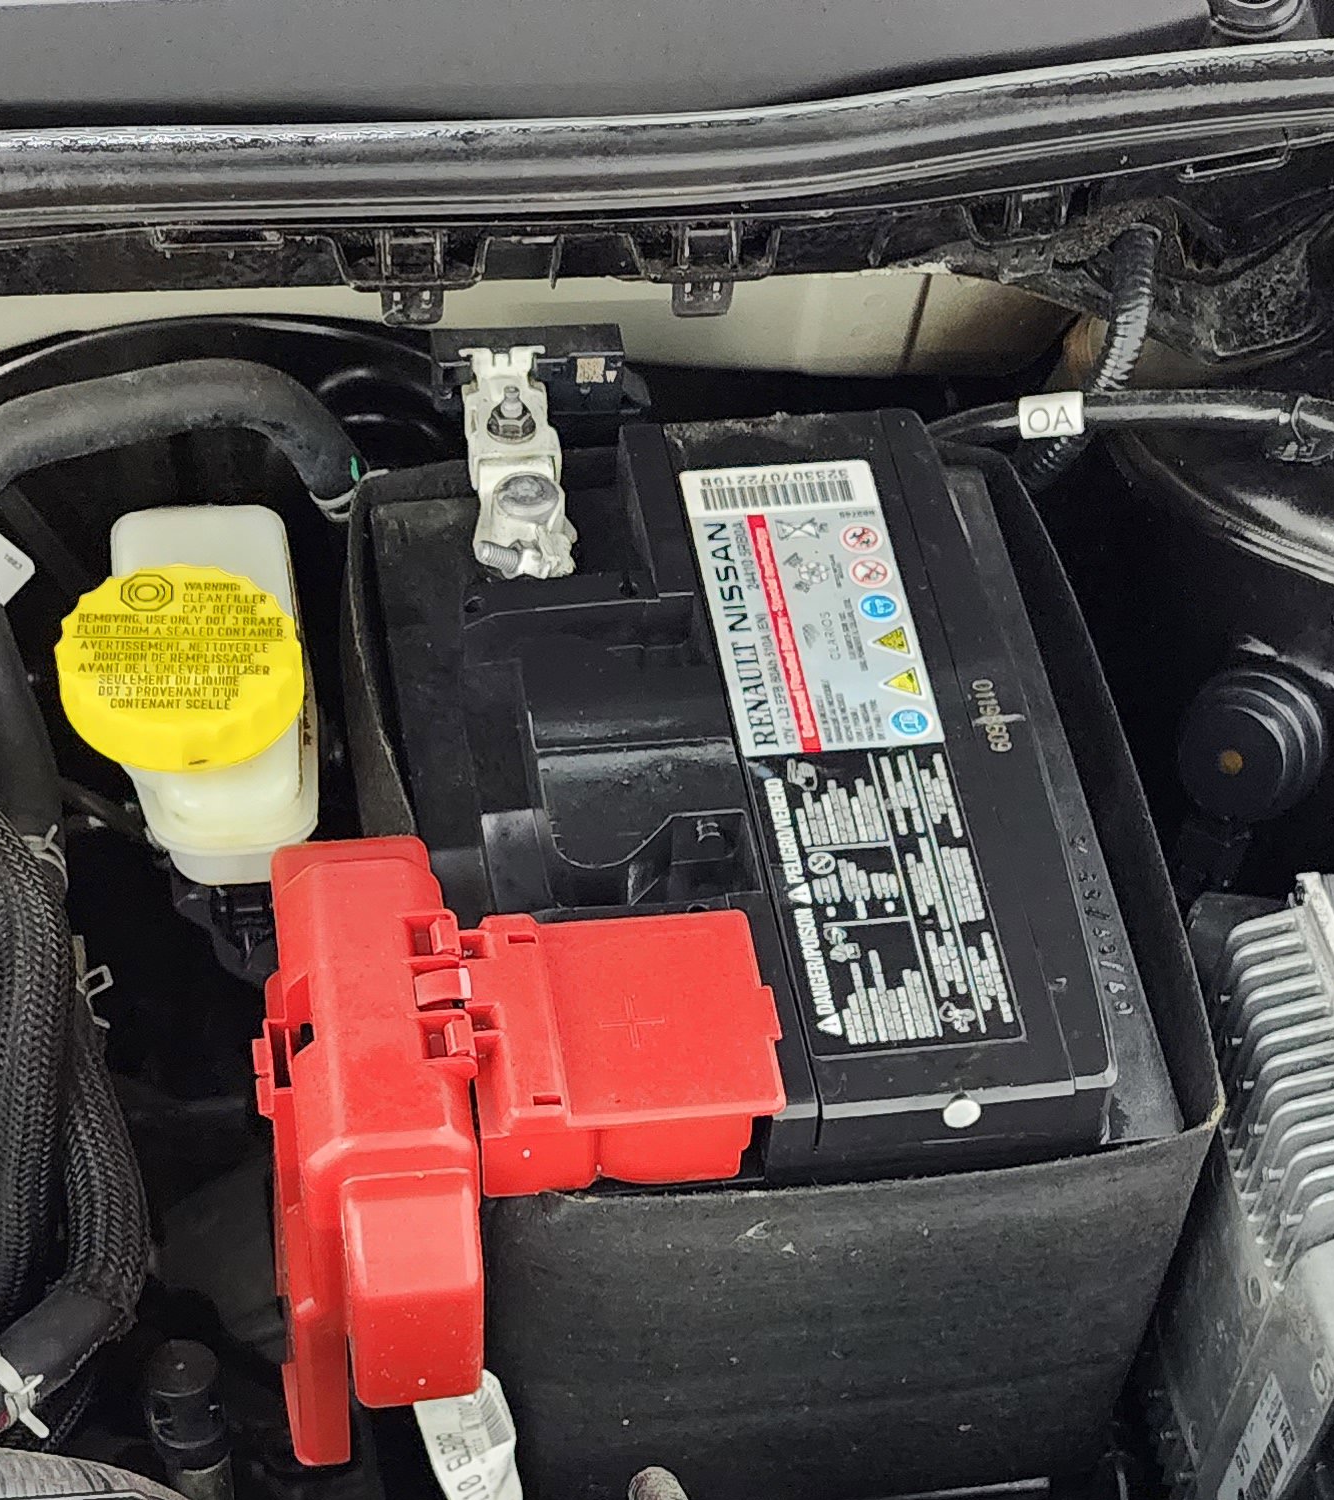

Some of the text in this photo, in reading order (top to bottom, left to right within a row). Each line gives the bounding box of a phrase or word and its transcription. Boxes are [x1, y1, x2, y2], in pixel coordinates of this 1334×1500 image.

[183, 593, 267, 605] CLEAN FILLER
[145, 614, 168, 625] USE
[170, 615, 201, 626] ONLY
[242, 616, 283, 627] BRAKE
[76, 625, 111, 635] FLUID
[116, 625, 150, 636] FROM
[154, 626, 162, 636] A
[166, 626, 214, 637] SEALED
[702, 521, 779, 748] RENAULT NISSAN
[189, 642, 251, 653] NETTOYER
[254, 643, 269, 653] LE
[94, 651, 255, 664] BOUCHON DE REMPLISSAGE
[78, 663, 120, 673] AVANT
[124, 664, 140, 674] DE
[217, 665, 271, 676] UTILISER
[98, 674, 240, 687] SEULEMENT DU LIQUIDE
[136, 686, 208, 697] PROVENANT
[110, 698, 180, 709] CONTENANT
[761, 777, 837, 1015] DANGER/POISON PELIGRO/VENENO
